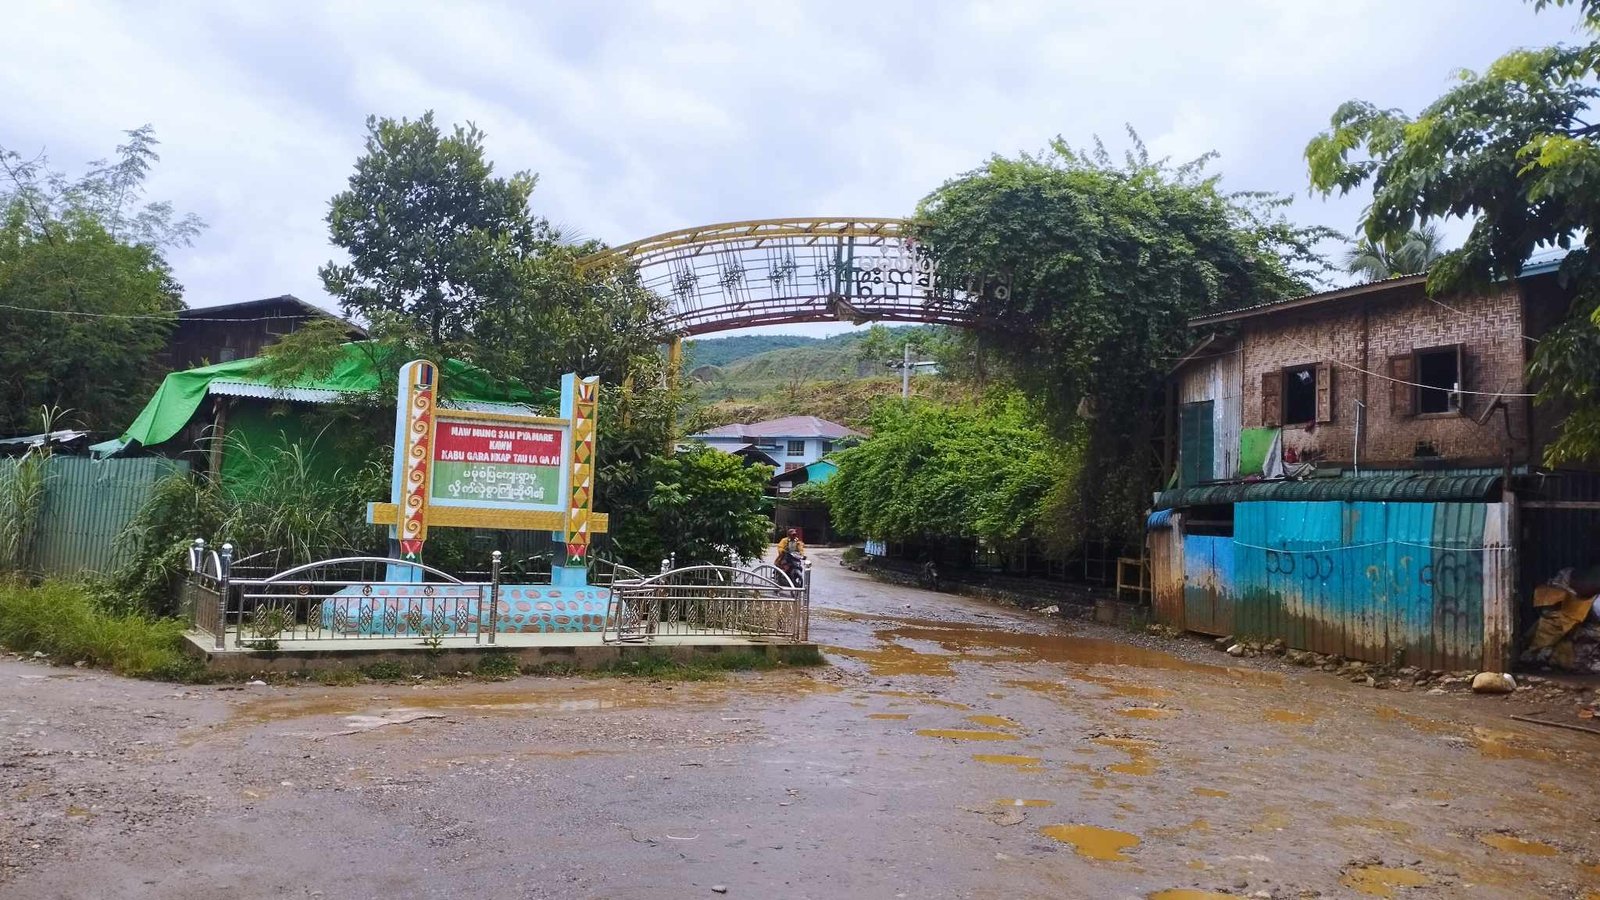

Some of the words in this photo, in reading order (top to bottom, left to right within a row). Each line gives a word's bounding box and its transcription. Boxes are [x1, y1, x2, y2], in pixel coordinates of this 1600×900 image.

[441, 449, 464, 460] KABU
[467, 451, 489, 461] GARA
[513, 453, 528, 463] TAU
[528, 454, 538, 464] LA
